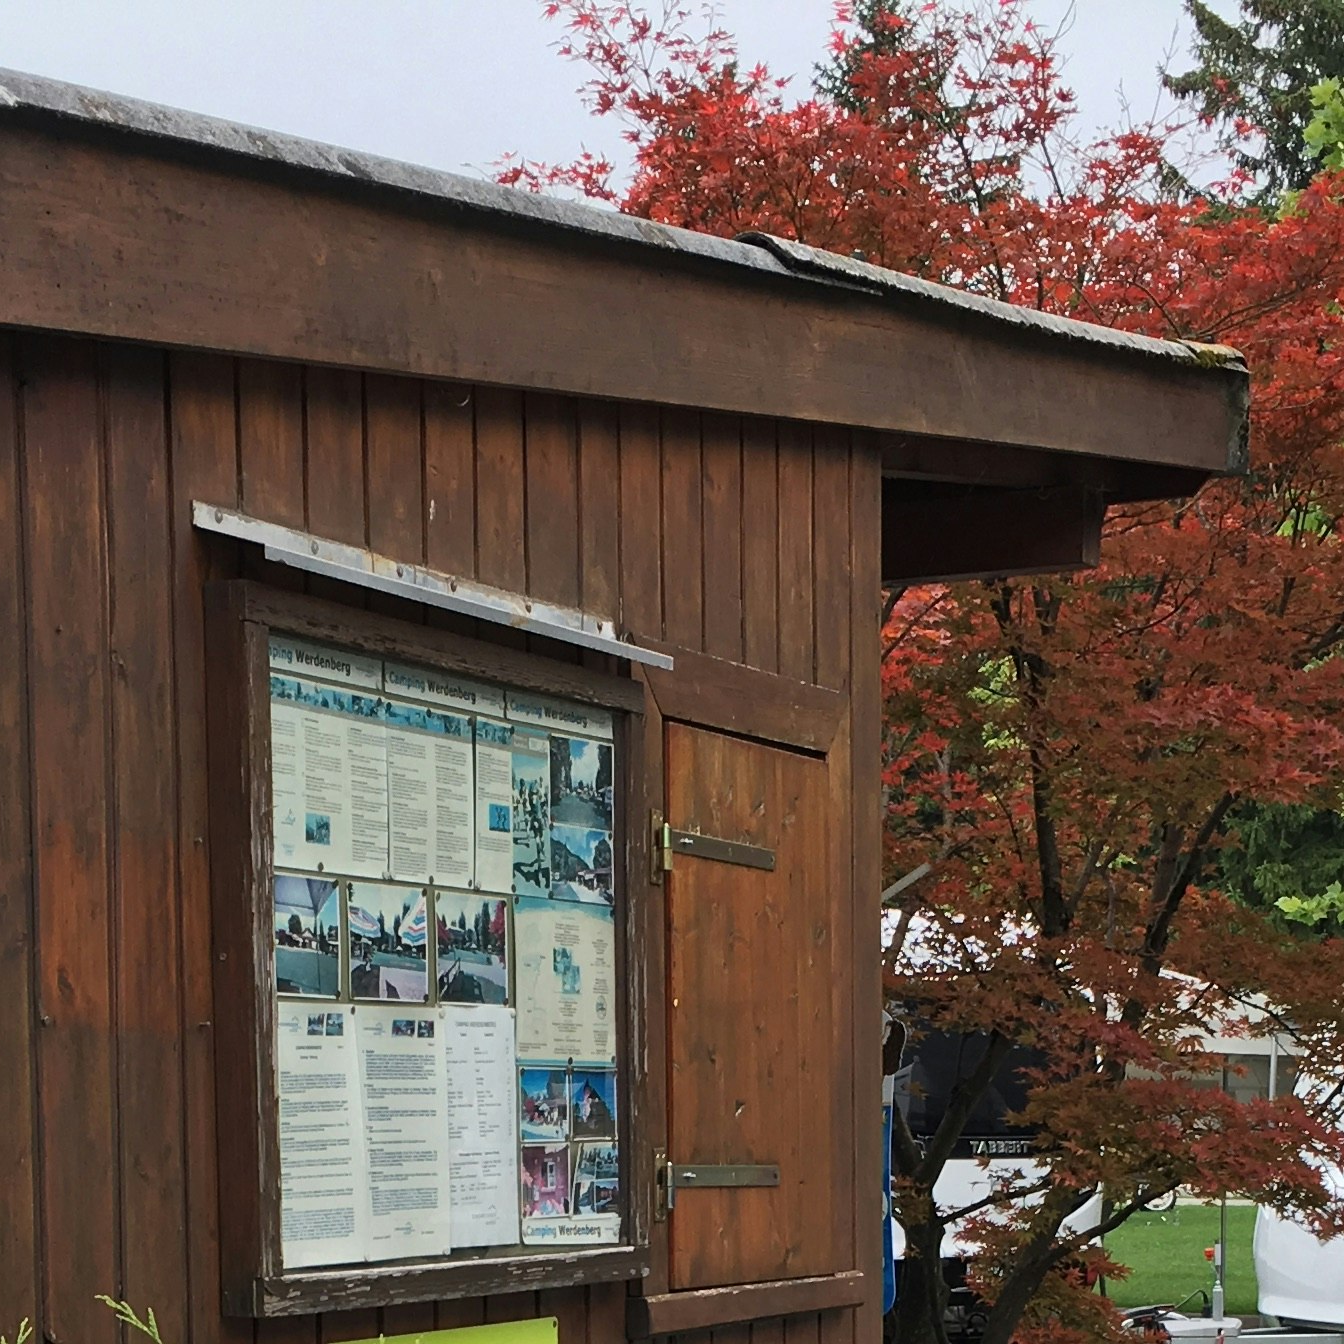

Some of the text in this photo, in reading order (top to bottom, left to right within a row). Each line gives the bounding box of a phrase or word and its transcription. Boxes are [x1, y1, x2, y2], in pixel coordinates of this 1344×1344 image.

[295, 648, 351, 677] Werdenberg
[389, 670, 476, 705] Camping Werdenberg
[543, 705, 587, 729] Werdenberg
[969, 1140, 1030, 1154] TABBERT
[526, 1223, 601, 1239] Camping Werdenberg
